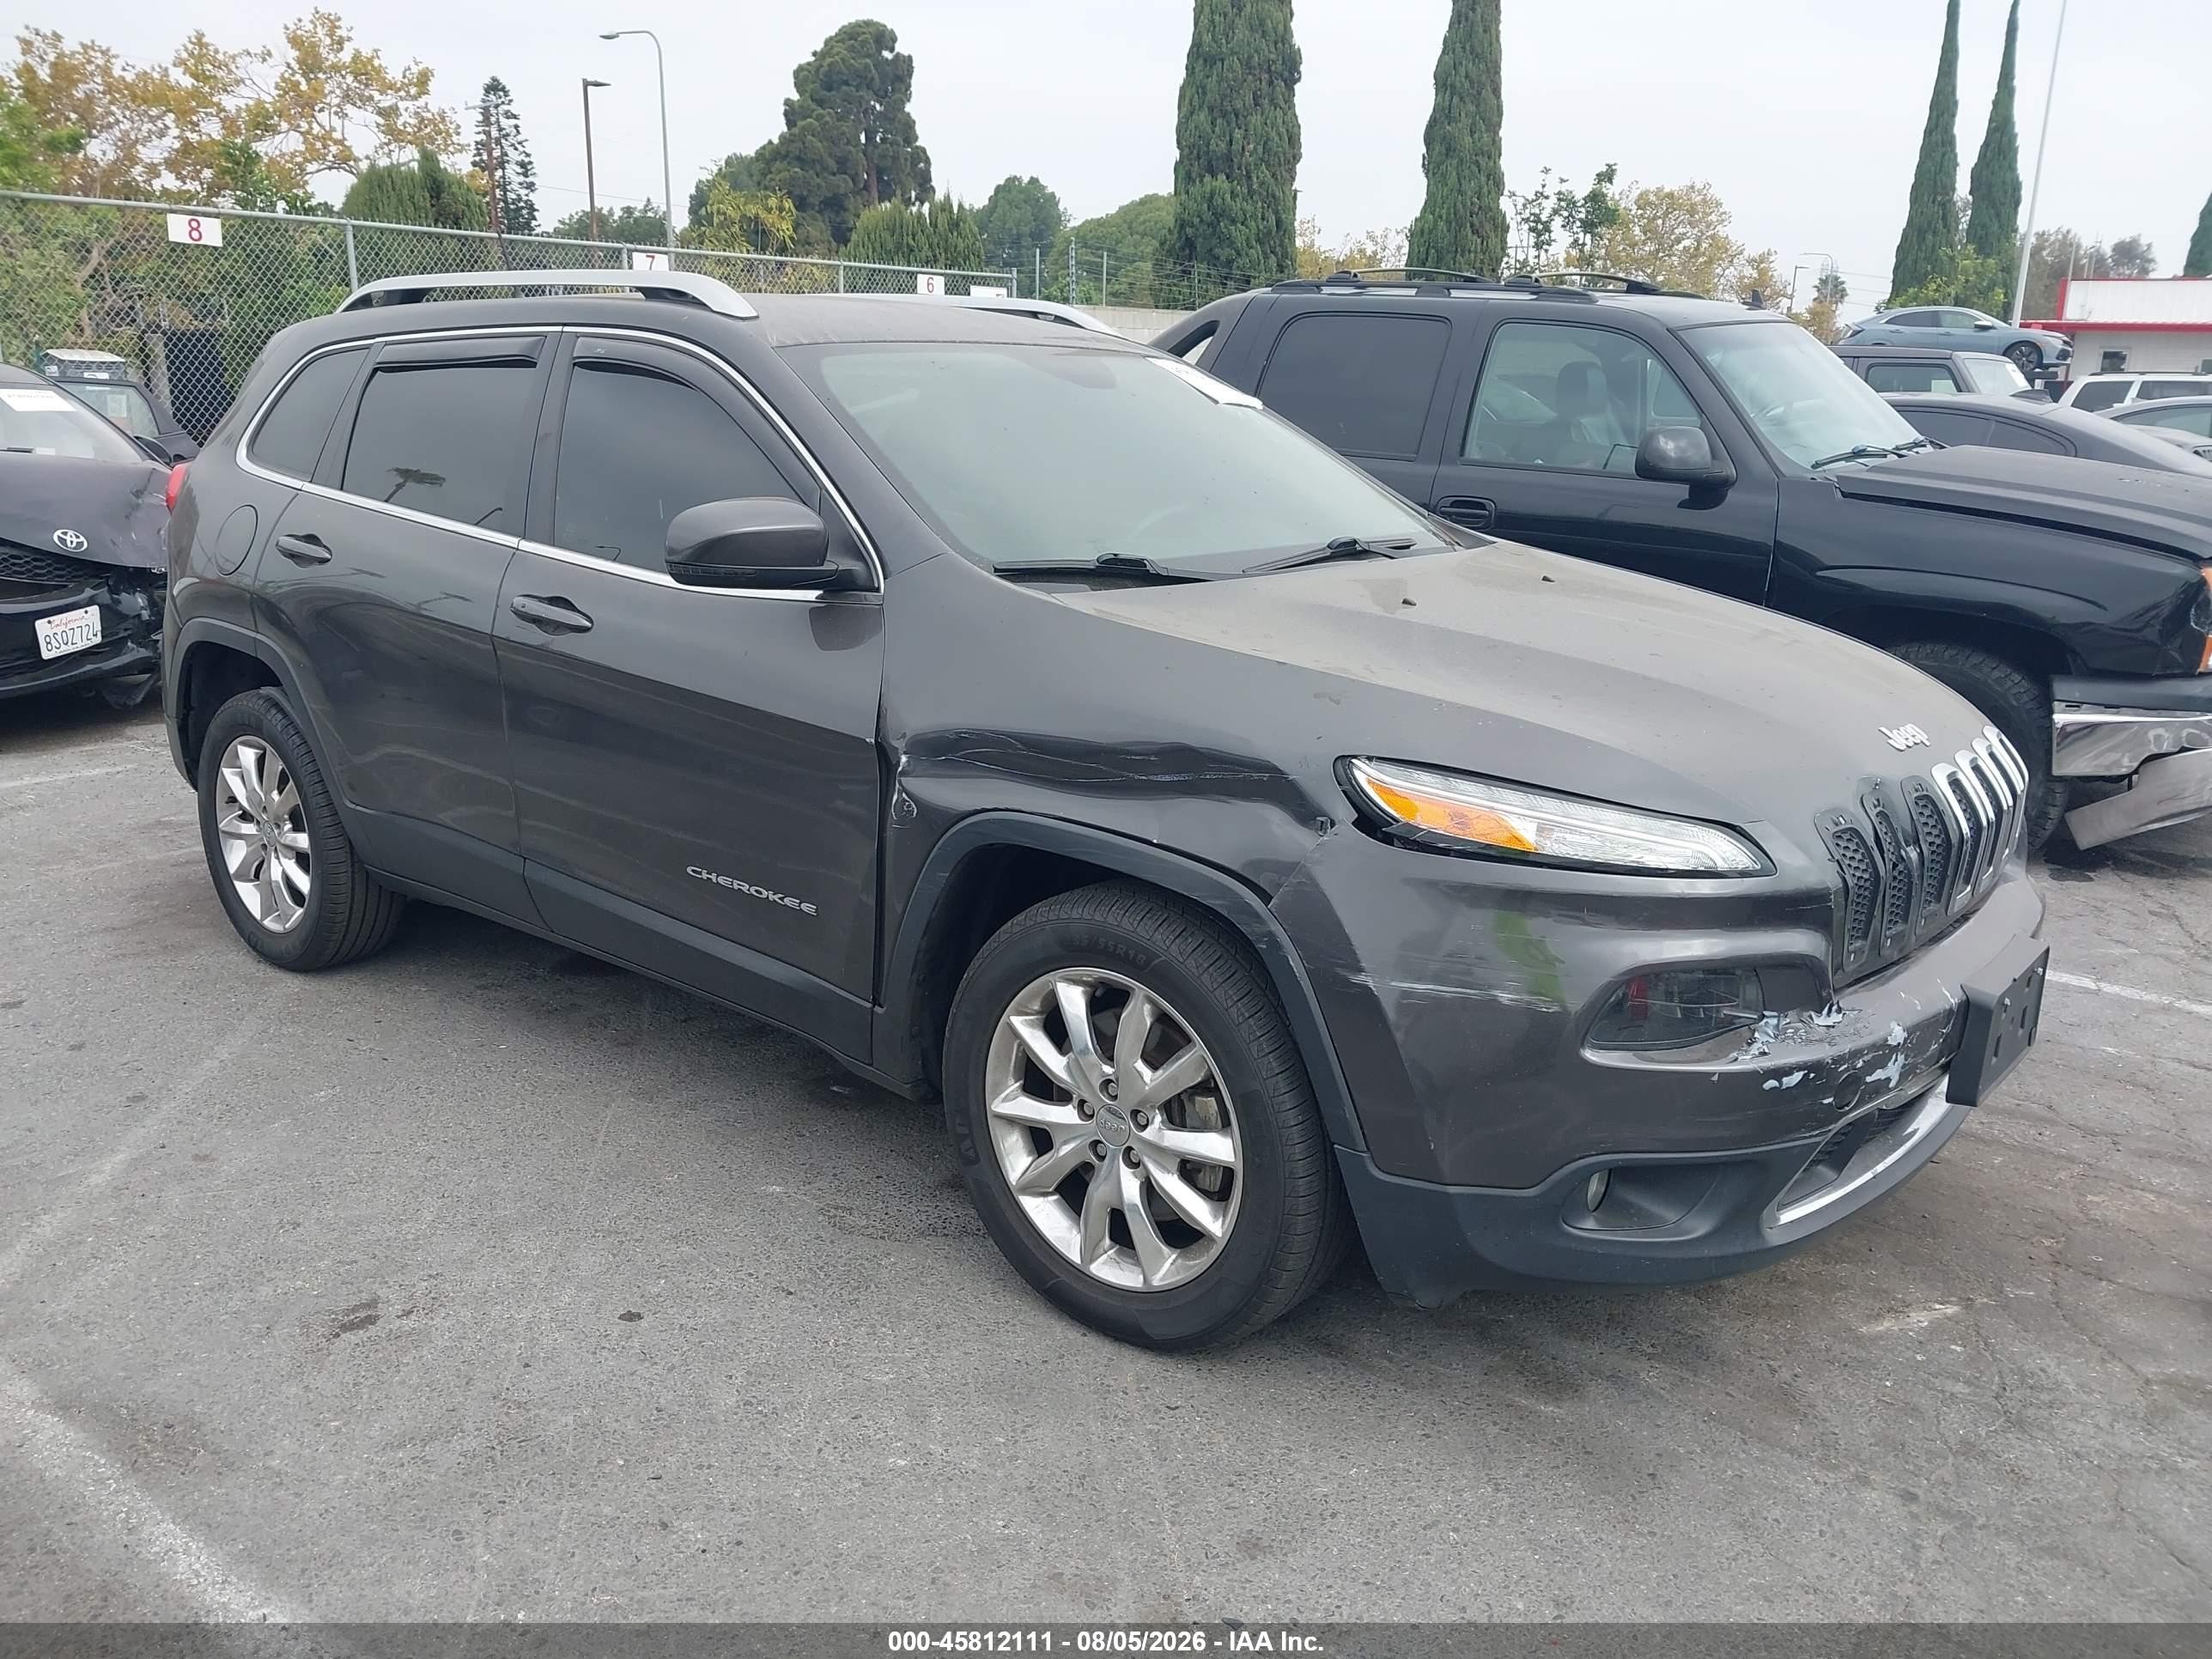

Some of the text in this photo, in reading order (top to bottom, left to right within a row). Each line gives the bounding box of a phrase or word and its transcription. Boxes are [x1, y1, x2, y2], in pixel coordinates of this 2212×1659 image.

[188, 218, 203, 242] 8
[646, 254, 655, 271] 7
[927, 276, 934, 293] 6
[1878, 723, 1931, 752] Jeep
[686, 866, 818, 916] CHEROKEE
